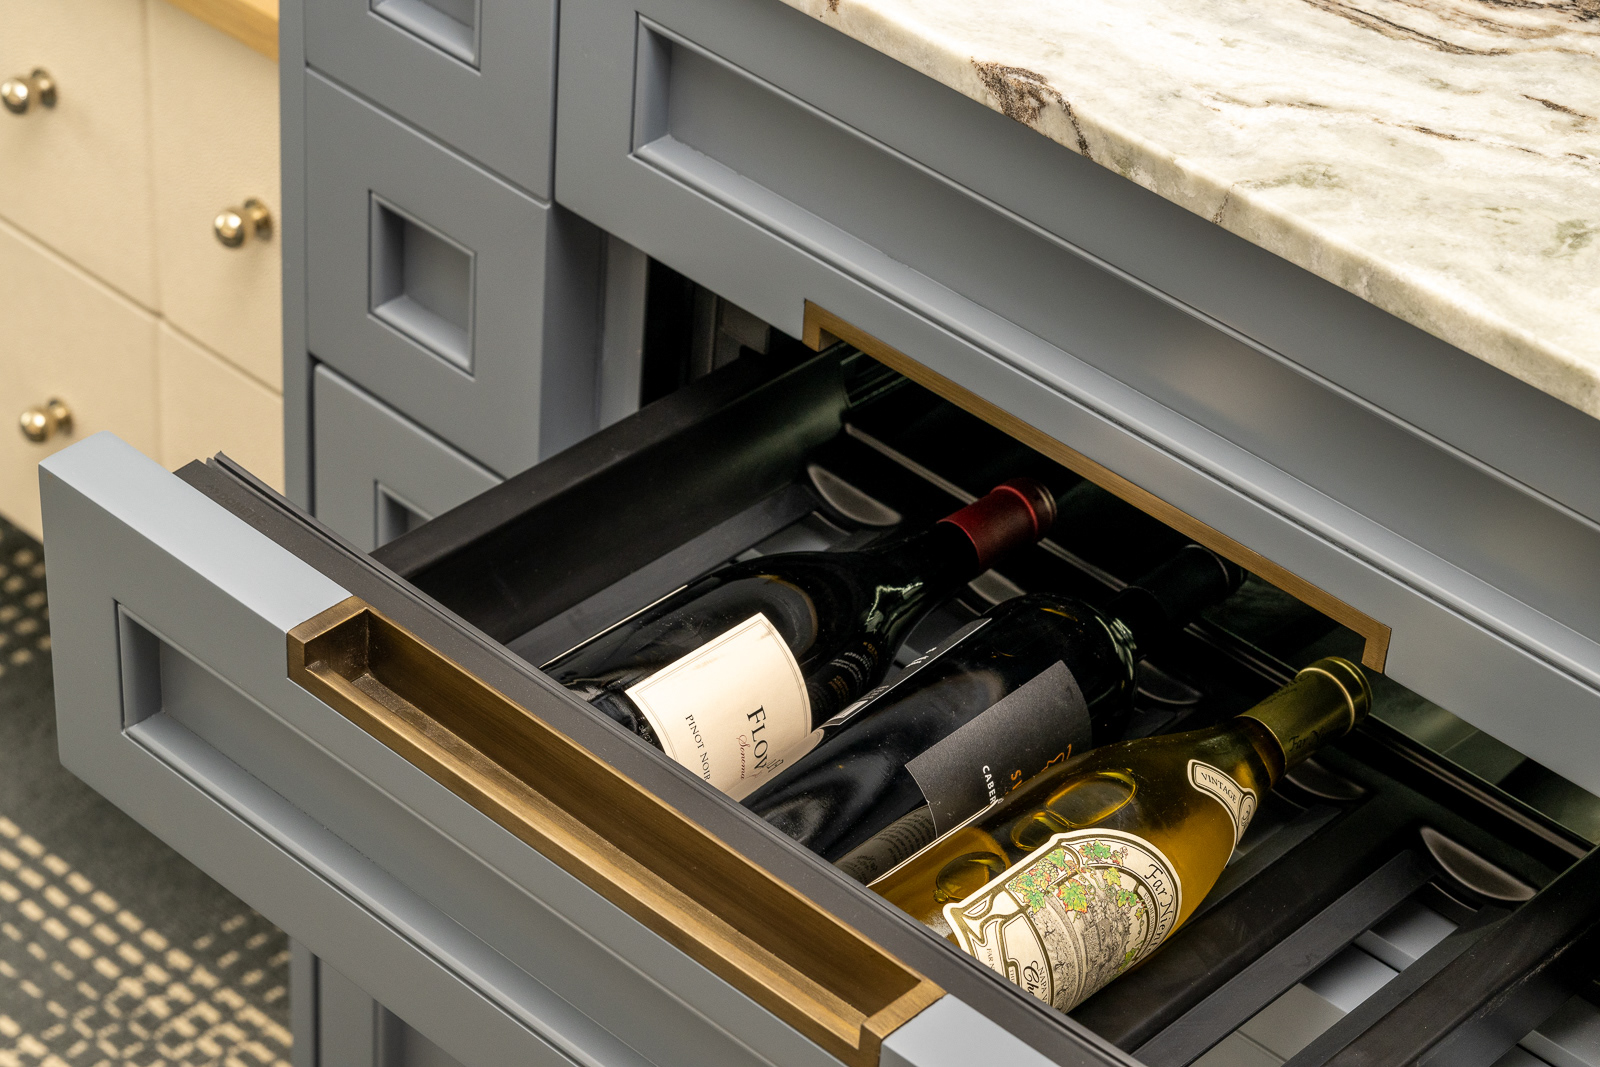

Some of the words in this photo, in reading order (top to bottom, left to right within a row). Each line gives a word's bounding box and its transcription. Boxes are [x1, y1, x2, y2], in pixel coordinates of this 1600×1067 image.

[685, 714, 705, 749] PINOT
[700, 752, 711, 782] NOIR
[736, 734, 750, 780] Sonoma
[1201, 772, 1237, 803] VINTAGE
[1144, 863, 1168, 896] Far
[1038, 966, 1047, 993] NAPA
